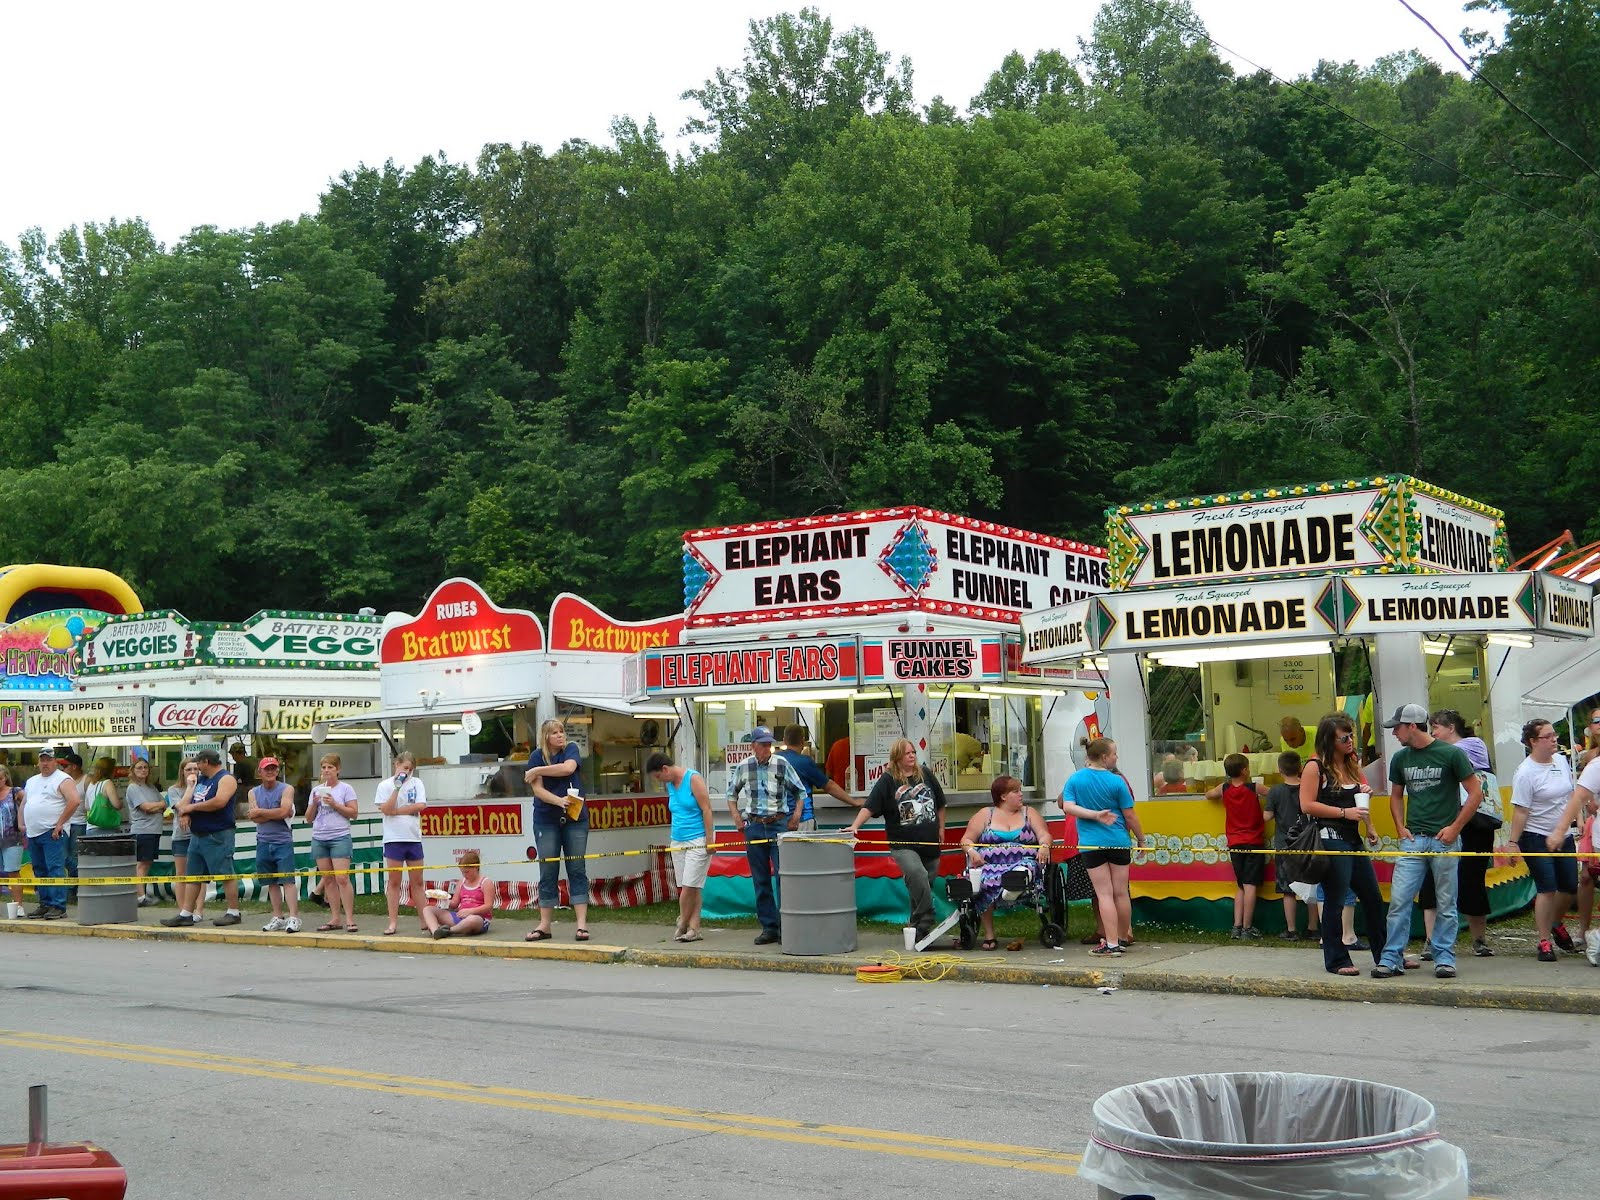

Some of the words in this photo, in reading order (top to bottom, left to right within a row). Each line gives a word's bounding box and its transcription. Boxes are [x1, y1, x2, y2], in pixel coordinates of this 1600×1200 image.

[1192, 508, 1234, 524] Fresh
[1238, 501, 1306, 518] Squeezed
[1436, 503, 1450, 515] Fresh
[725, 527, 870, 570] ELEPHANT
[1152, 514, 1355, 578] LEMONADE
[1419, 512, 1493, 572] LEMONADE
[946, 529, 1050, 577] ELEPHANT
[1065, 554, 1110, 588] EARS
[755, 570, 841, 606] EARS
[952, 569, 1032, 609] FUNNEL
[1175, 592, 1203, 603] Fresh
[1206, 588, 1251, 601] Squeezed
[1402, 582, 1428, 591] Fresh
[1431, 581, 1471, 591] Squeezed
[436, 600, 478, 621] RUBES
[1126, 598, 1306, 641] LEMONADE
[1368, 596, 1509, 621] LEMONADE
[1548, 593, 1589, 628] LEMONADE
[113, 623, 139, 637] BATTER
[140, 621, 166, 634] DIPPED
[272, 622, 339, 635] BATTER
[343, 625, 381, 637] DIPP
[568, 618, 670, 649] Bratwurst
[1028, 621, 1083, 652] LEMONADE
[103, 635, 177, 658] VEGGIES
[401, 623, 512, 661] Bratwurst
[890, 641, 975, 658] FUNNEL
[663, 651, 773, 688] ELEPHANT
[775, 644, 839, 682] EARS
[896, 659, 970, 677] CAKES
[29, 704, 64, 712] BATTER
[69, 702, 104, 711] DIPPED
[157, 703, 241, 727] Coca-Cola
[330, 700, 372, 708] DIPPED
[29, 712, 105, 735] Mushrooms
[110, 716, 136, 724] BIRCH
[112, 725, 135, 733] BEER
